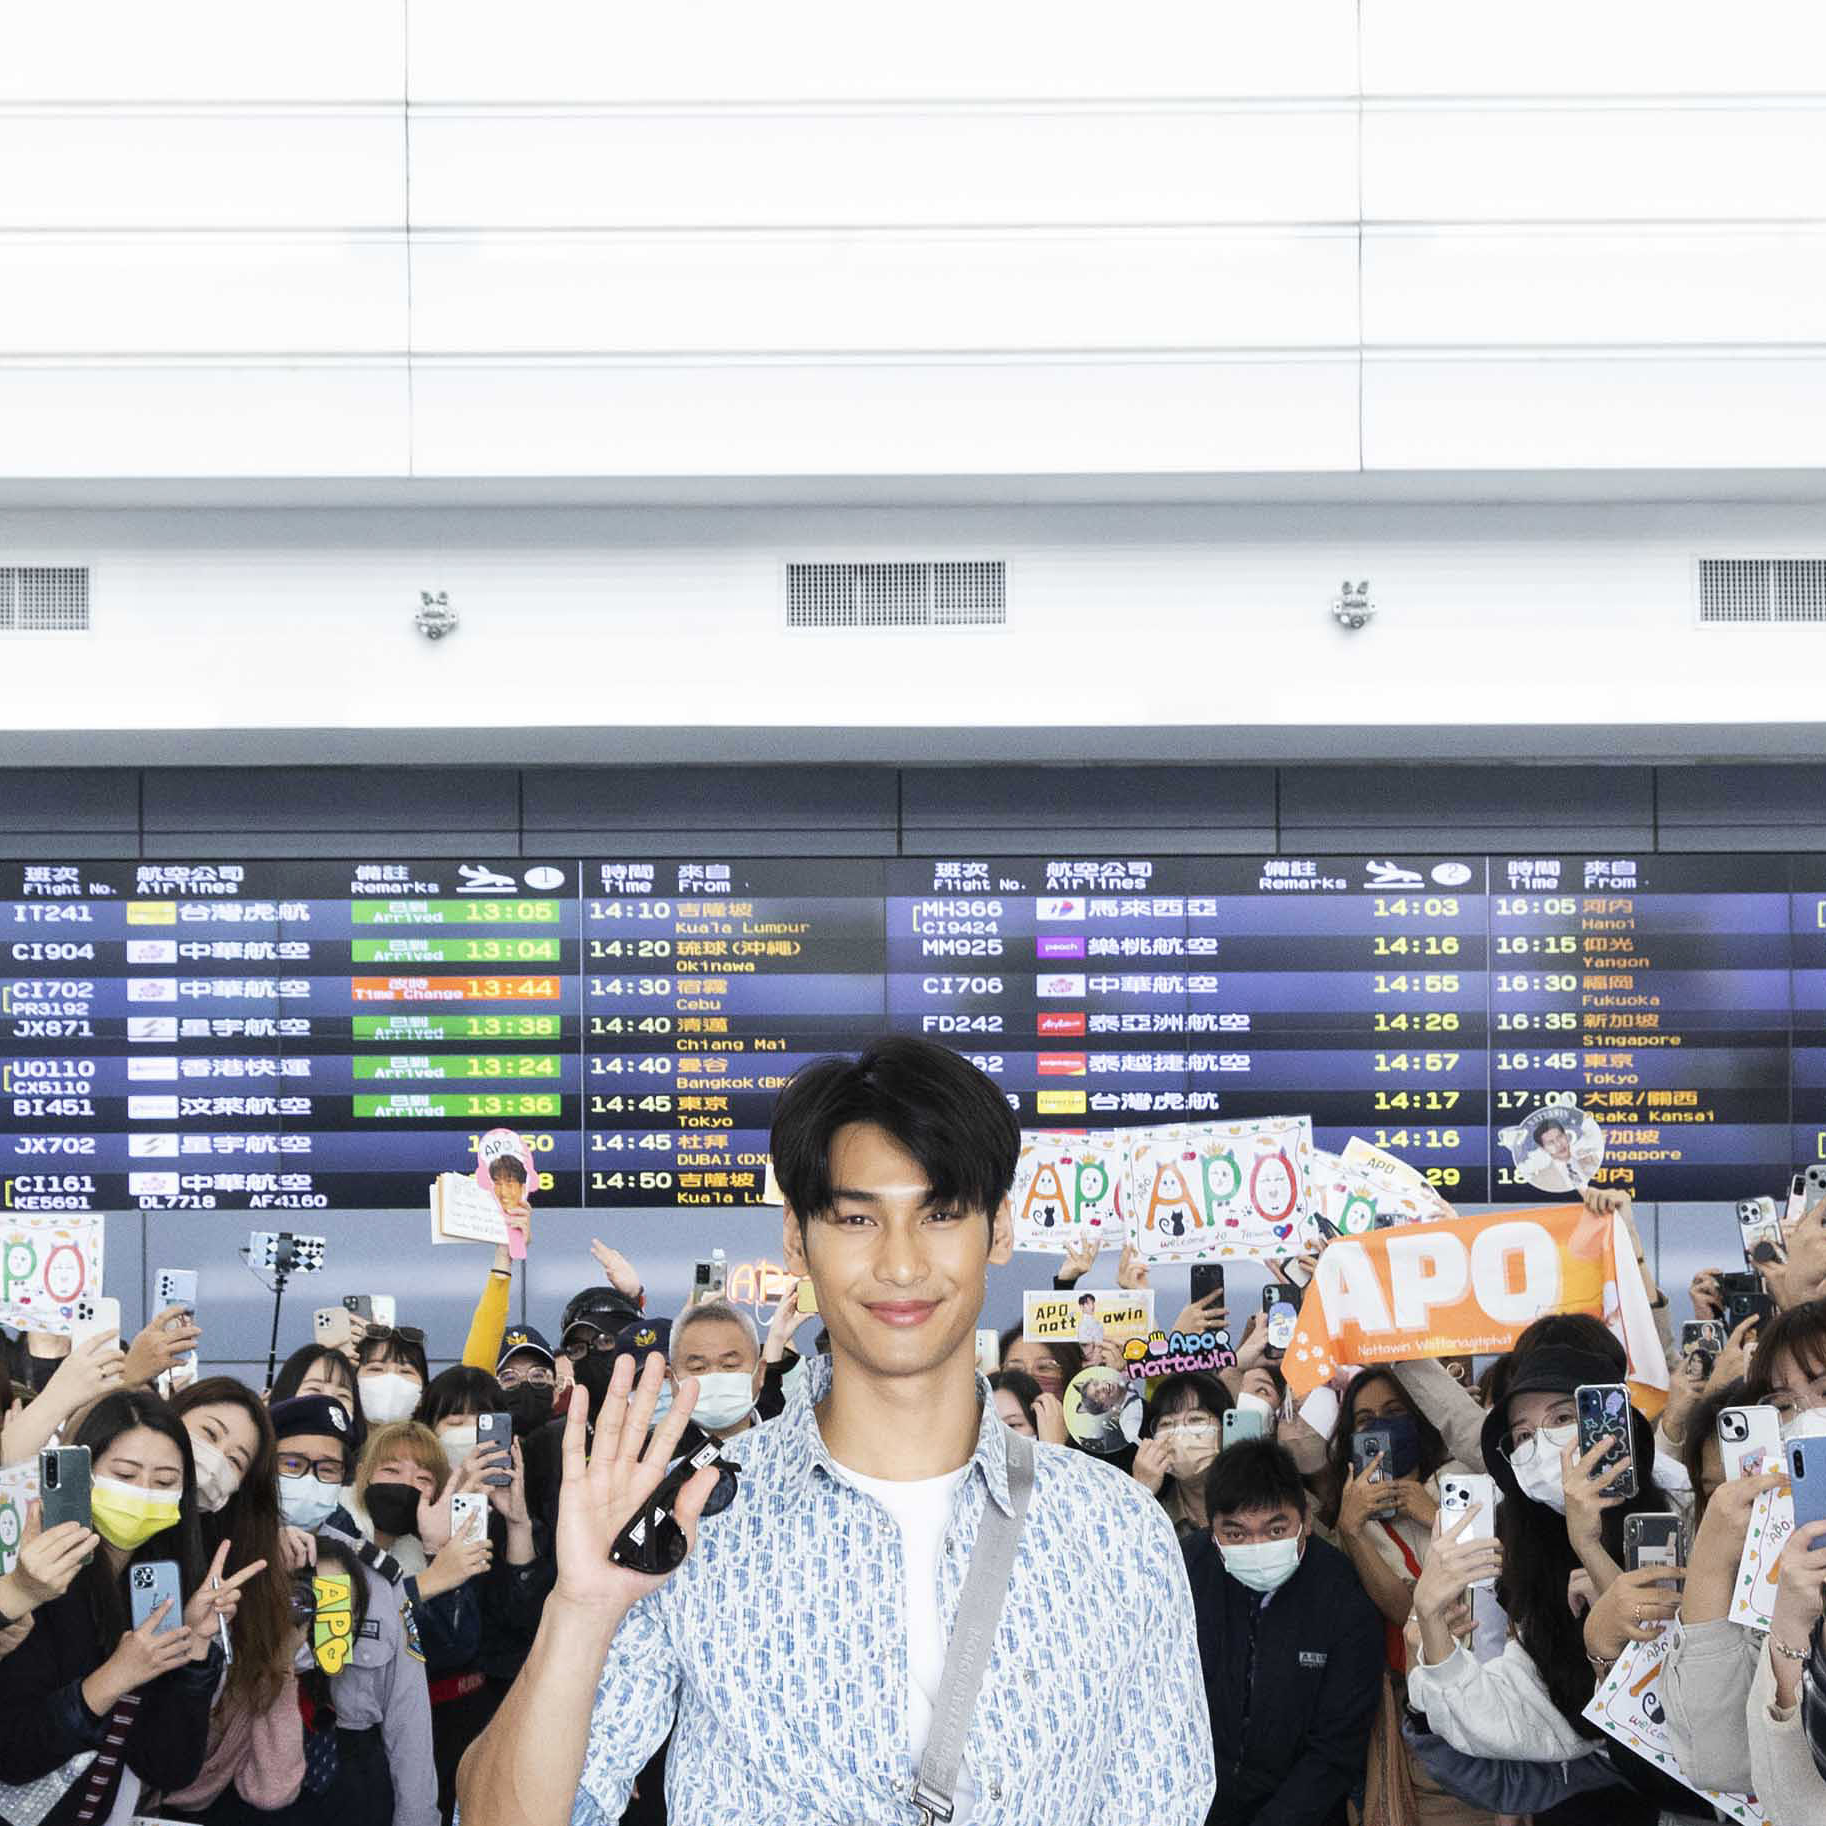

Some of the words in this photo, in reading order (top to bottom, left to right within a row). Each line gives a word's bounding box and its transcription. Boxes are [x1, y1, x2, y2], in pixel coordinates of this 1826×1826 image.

[23, 882, 83, 896] Flight
[137, 881, 238, 894] Airlines
[351, 881, 439, 894] Remarks
[602, 880, 652, 892] Time
[679, 880, 730, 892] From
[934, 879, 991, 892] Flight
[1047, 878, 1146, 890] Airlines
[1260, 878, 1346, 890] Remarks
[1509, 876, 1558, 889] Time
[1584, 876, 1636, 888] From
[14, 905, 93, 921] IT241
[179, 904, 310, 921] 台灣虎航
[466, 904, 552, 920] 13:05
[590, 903, 670, 918] 14:10
[922, 902, 1002, 917] MH366
[1374, 899, 1459, 915] 14:03
[1497, 899, 1575, 914] 16:05
[676, 922, 731, 933] Kuala
[742, 922, 810, 934] Lumpur
[922, 922, 998, 935] CI9424
[1583, 919, 1635, 929] Hanoi
[12, 944, 94, 959] CI904
[179, 943, 310, 959] 中華航空
[466, 943, 552, 959] 13:04
[590, 941, 670, 956] 14:20
[922, 940, 1003, 955] MM925
[1089, 938, 1218, 955] 樂桃航空
[1375, 938, 1459, 953] 14:16
[1497, 938, 1575, 953] 16:15
[676, 961, 755, 972] Okinawa
[1584, 956, 1649, 969] Yangon
[13, 982, 93, 998] CI702
[179, 981, 310, 998] 中華航空
[467, 981, 553, 996] 13:44
[591, 980, 670, 995] 14:30
[923, 978, 1003, 993] CI706
[1089, 977, 1218, 993] 中華航空
[1375, 976, 1459, 992] 14:55
[1497, 976, 1576, 991] 16:30
[676, 999, 721, 1010] Cebu
[1584, 995, 1659, 1006] Fukuoka
[12, 1002, 88, 1015] PR3192
[13, 1021, 93, 1037] JX871
[179, 1019, 310, 1036] 星宇航空
[467, 1019, 553, 1035] 13:38
[591, 1018, 670, 1033] 14:40
[922, 1017, 1003, 1032] FD242
[1089, 1015, 1250, 1031] 泰亞洲航空
[1375, 1014, 1459, 1030] 14:26
[1497, 1014, 1576, 1029] 16:35
[677, 1039, 744, 1051] Chiang
[1584, 1034, 1680, 1046] Singapore
[180, 1059, 310, 1076] 香港快運
[467, 1059, 553, 1075] 13:24
[591, 1058, 671, 1073] 14:40
[1089, 1054, 1250, 1070] 泰越捷航空
[1375, 1054, 1459, 1070] 14:57
[1497, 1054, 1576, 1069] 16:45
[1584, 1073, 1638, 1085] Tokyo
[13, 1081, 89, 1094] CX5110
[14, 1100, 94, 1115] BI451
[181, 1097, 310, 1114] 汶萊航空
[468, 1097, 553, 1113] 13:36
[591, 1097, 671, 1112] 14:45
[1089, 1093, 1218, 1109] 台灣虎航
[1375, 1093, 1459, 1108] 14:17
[678, 1115, 733, 1128] Tokyo
[1650, 1111, 1714, 1121] Kansai
[14, 1138, 94, 1153] JX702
[181, 1136, 311, 1152] 星宇航空
[592, 1135, 672, 1150] 14:45
[1375, 1130, 1459, 1146] 14:16
[1367, 1158, 1397, 1175] APO
[14, 1177, 94, 1192] CI161
[181, 1174, 311, 1190] 中華航空
[592, 1173, 672, 1188] 14:50
[1022, 1155, 1125, 1223] AP
[1145, 1147, 1298, 1230] APO
[14, 1196, 90, 1209] KE5691
[139, 1196, 215, 1208] DL7718
[678, 1192, 733, 1204] Kuala
[1316, 1221, 1562, 1339] APO
[1036, 1304, 1068, 1320] APO
[1103, 1307, 1143, 1324] awin
[1169, 1332, 1215, 1354] Apo
[1358, 1340, 1411, 1357] Nattawin
[1127, 1350, 1236, 1379] nattawin
